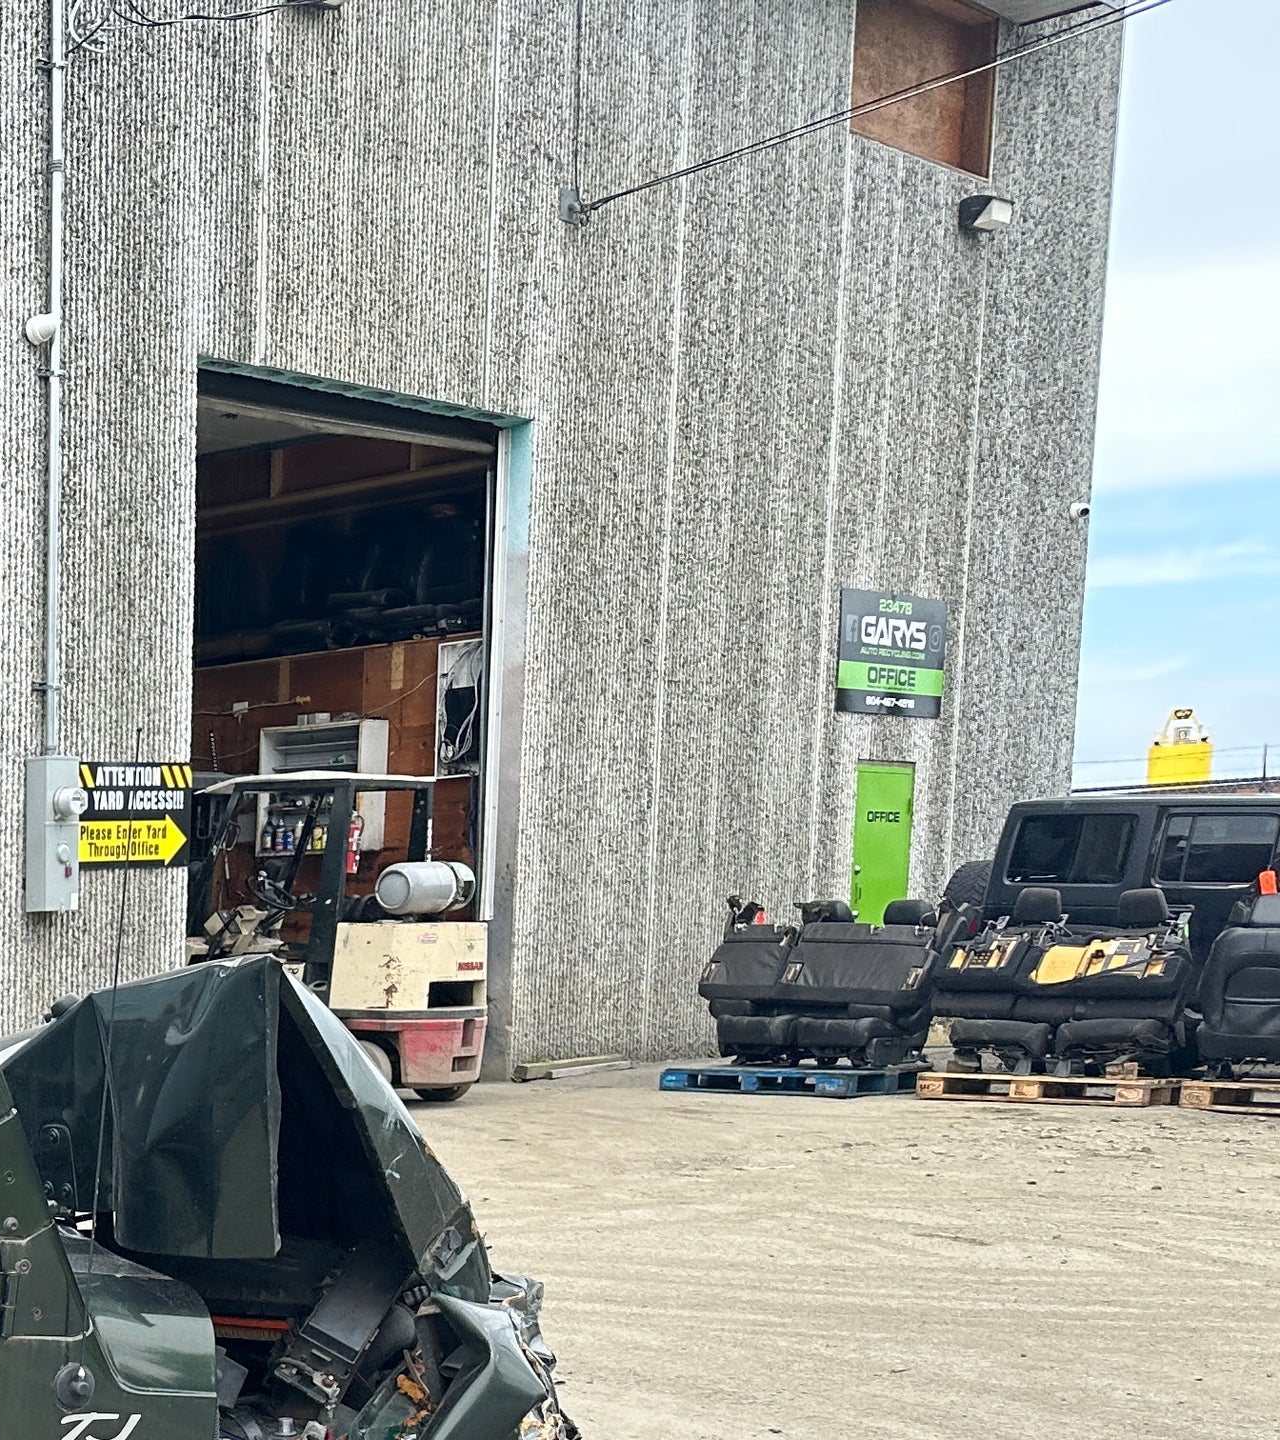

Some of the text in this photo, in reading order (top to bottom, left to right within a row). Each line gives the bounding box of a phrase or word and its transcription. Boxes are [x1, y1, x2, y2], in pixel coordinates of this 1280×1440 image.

[879, 598, 913, 615] 23478
[861, 615, 927, 650] GARYS
[867, 666, 916, 688] OFFICE
[95, 766, 161, 787] ATTENTION
[92, 790, 124, 811] YARD
[867, 811, 900, 823] OFFICE
[80, 825, 112, 841] Please
[146, 824, 167, 839] Yard
[88, 841, 160, 859] Through Office
